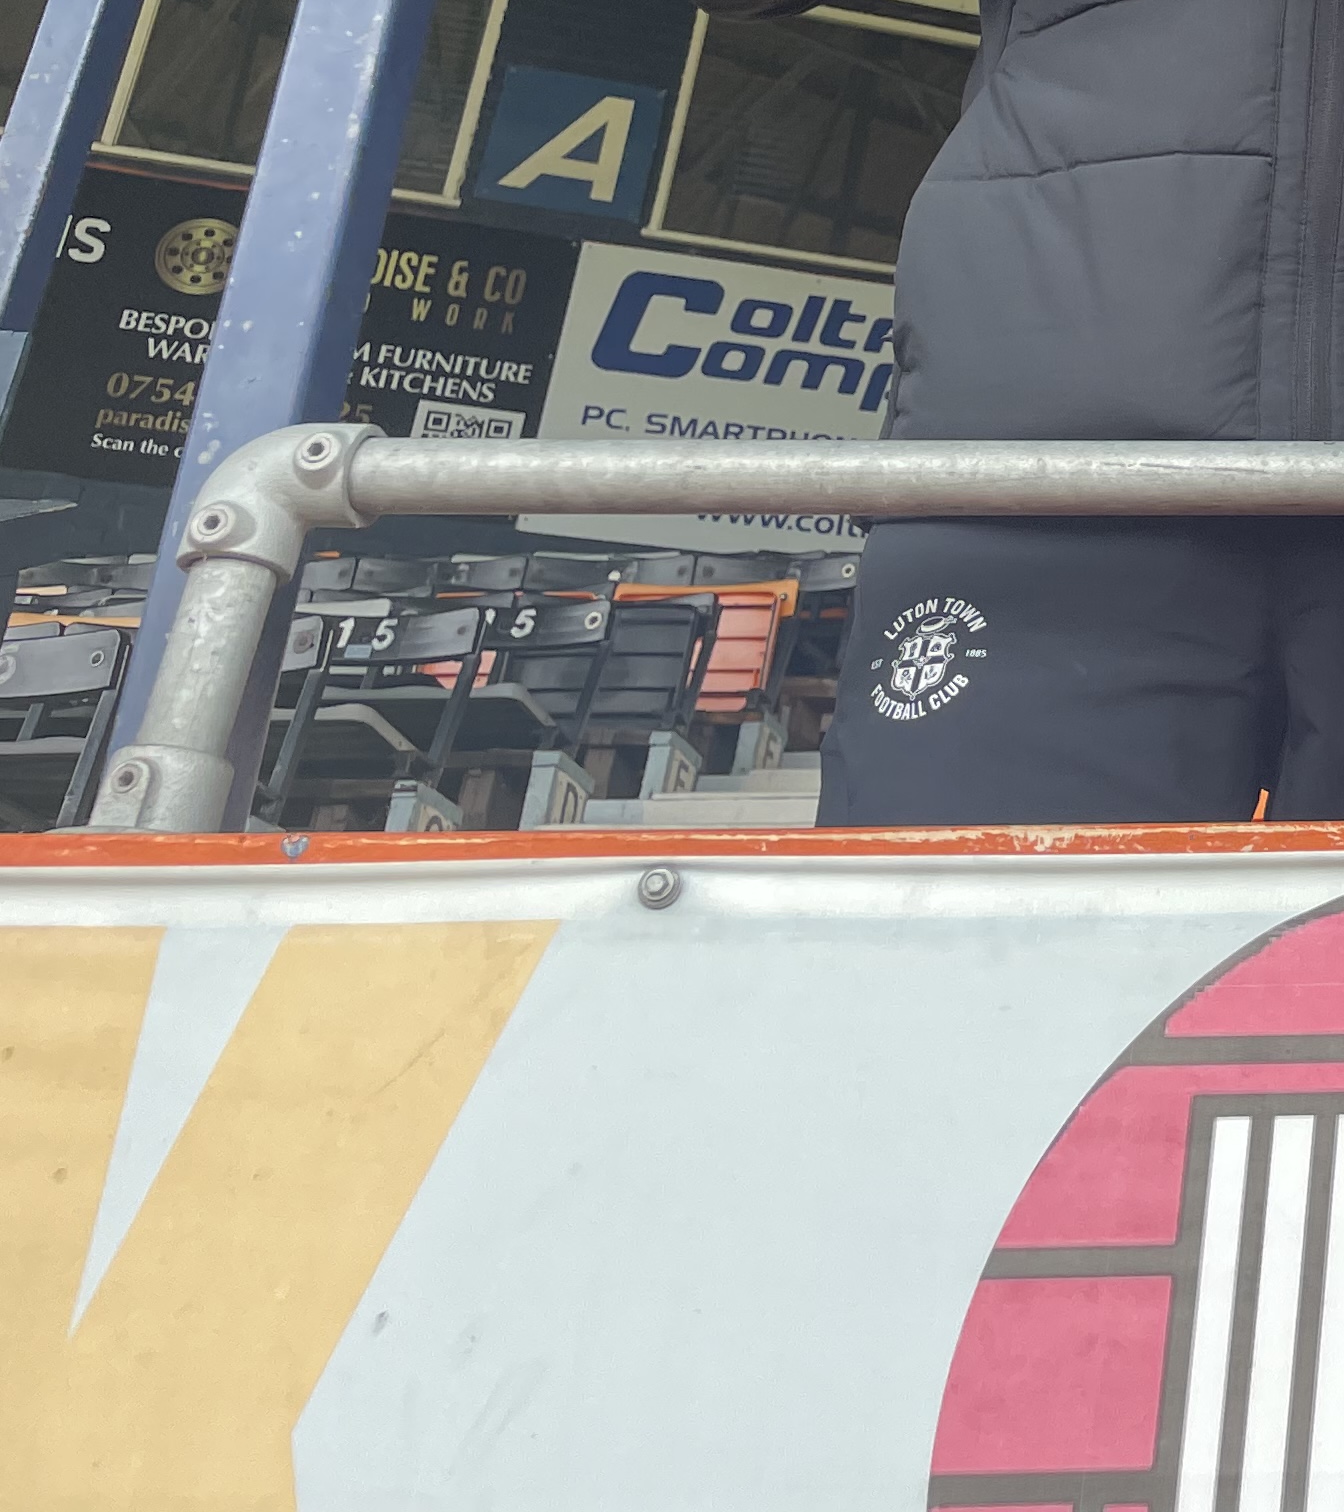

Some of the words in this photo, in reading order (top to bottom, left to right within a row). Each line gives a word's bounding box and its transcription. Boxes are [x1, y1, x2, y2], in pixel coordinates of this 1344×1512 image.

[498, 96, 635, 203] A
[56, 214, 112, 263] S
[447, 259, 469, 298] &
[484, 265, 527, 305] CO
[360, 366, 497, 403] KITCHENS
[377, 343, 534, 384] FURNITURE
[90, 432, 135, 453] Scan
[140, 436, 170, 456] the
[884, 598, 939, 640] LUTON
[943, 597, 987, 633] TOWN
[871, 683, 927, 721] FOOTBALL
[928, 674, 969, 710] CLUB
